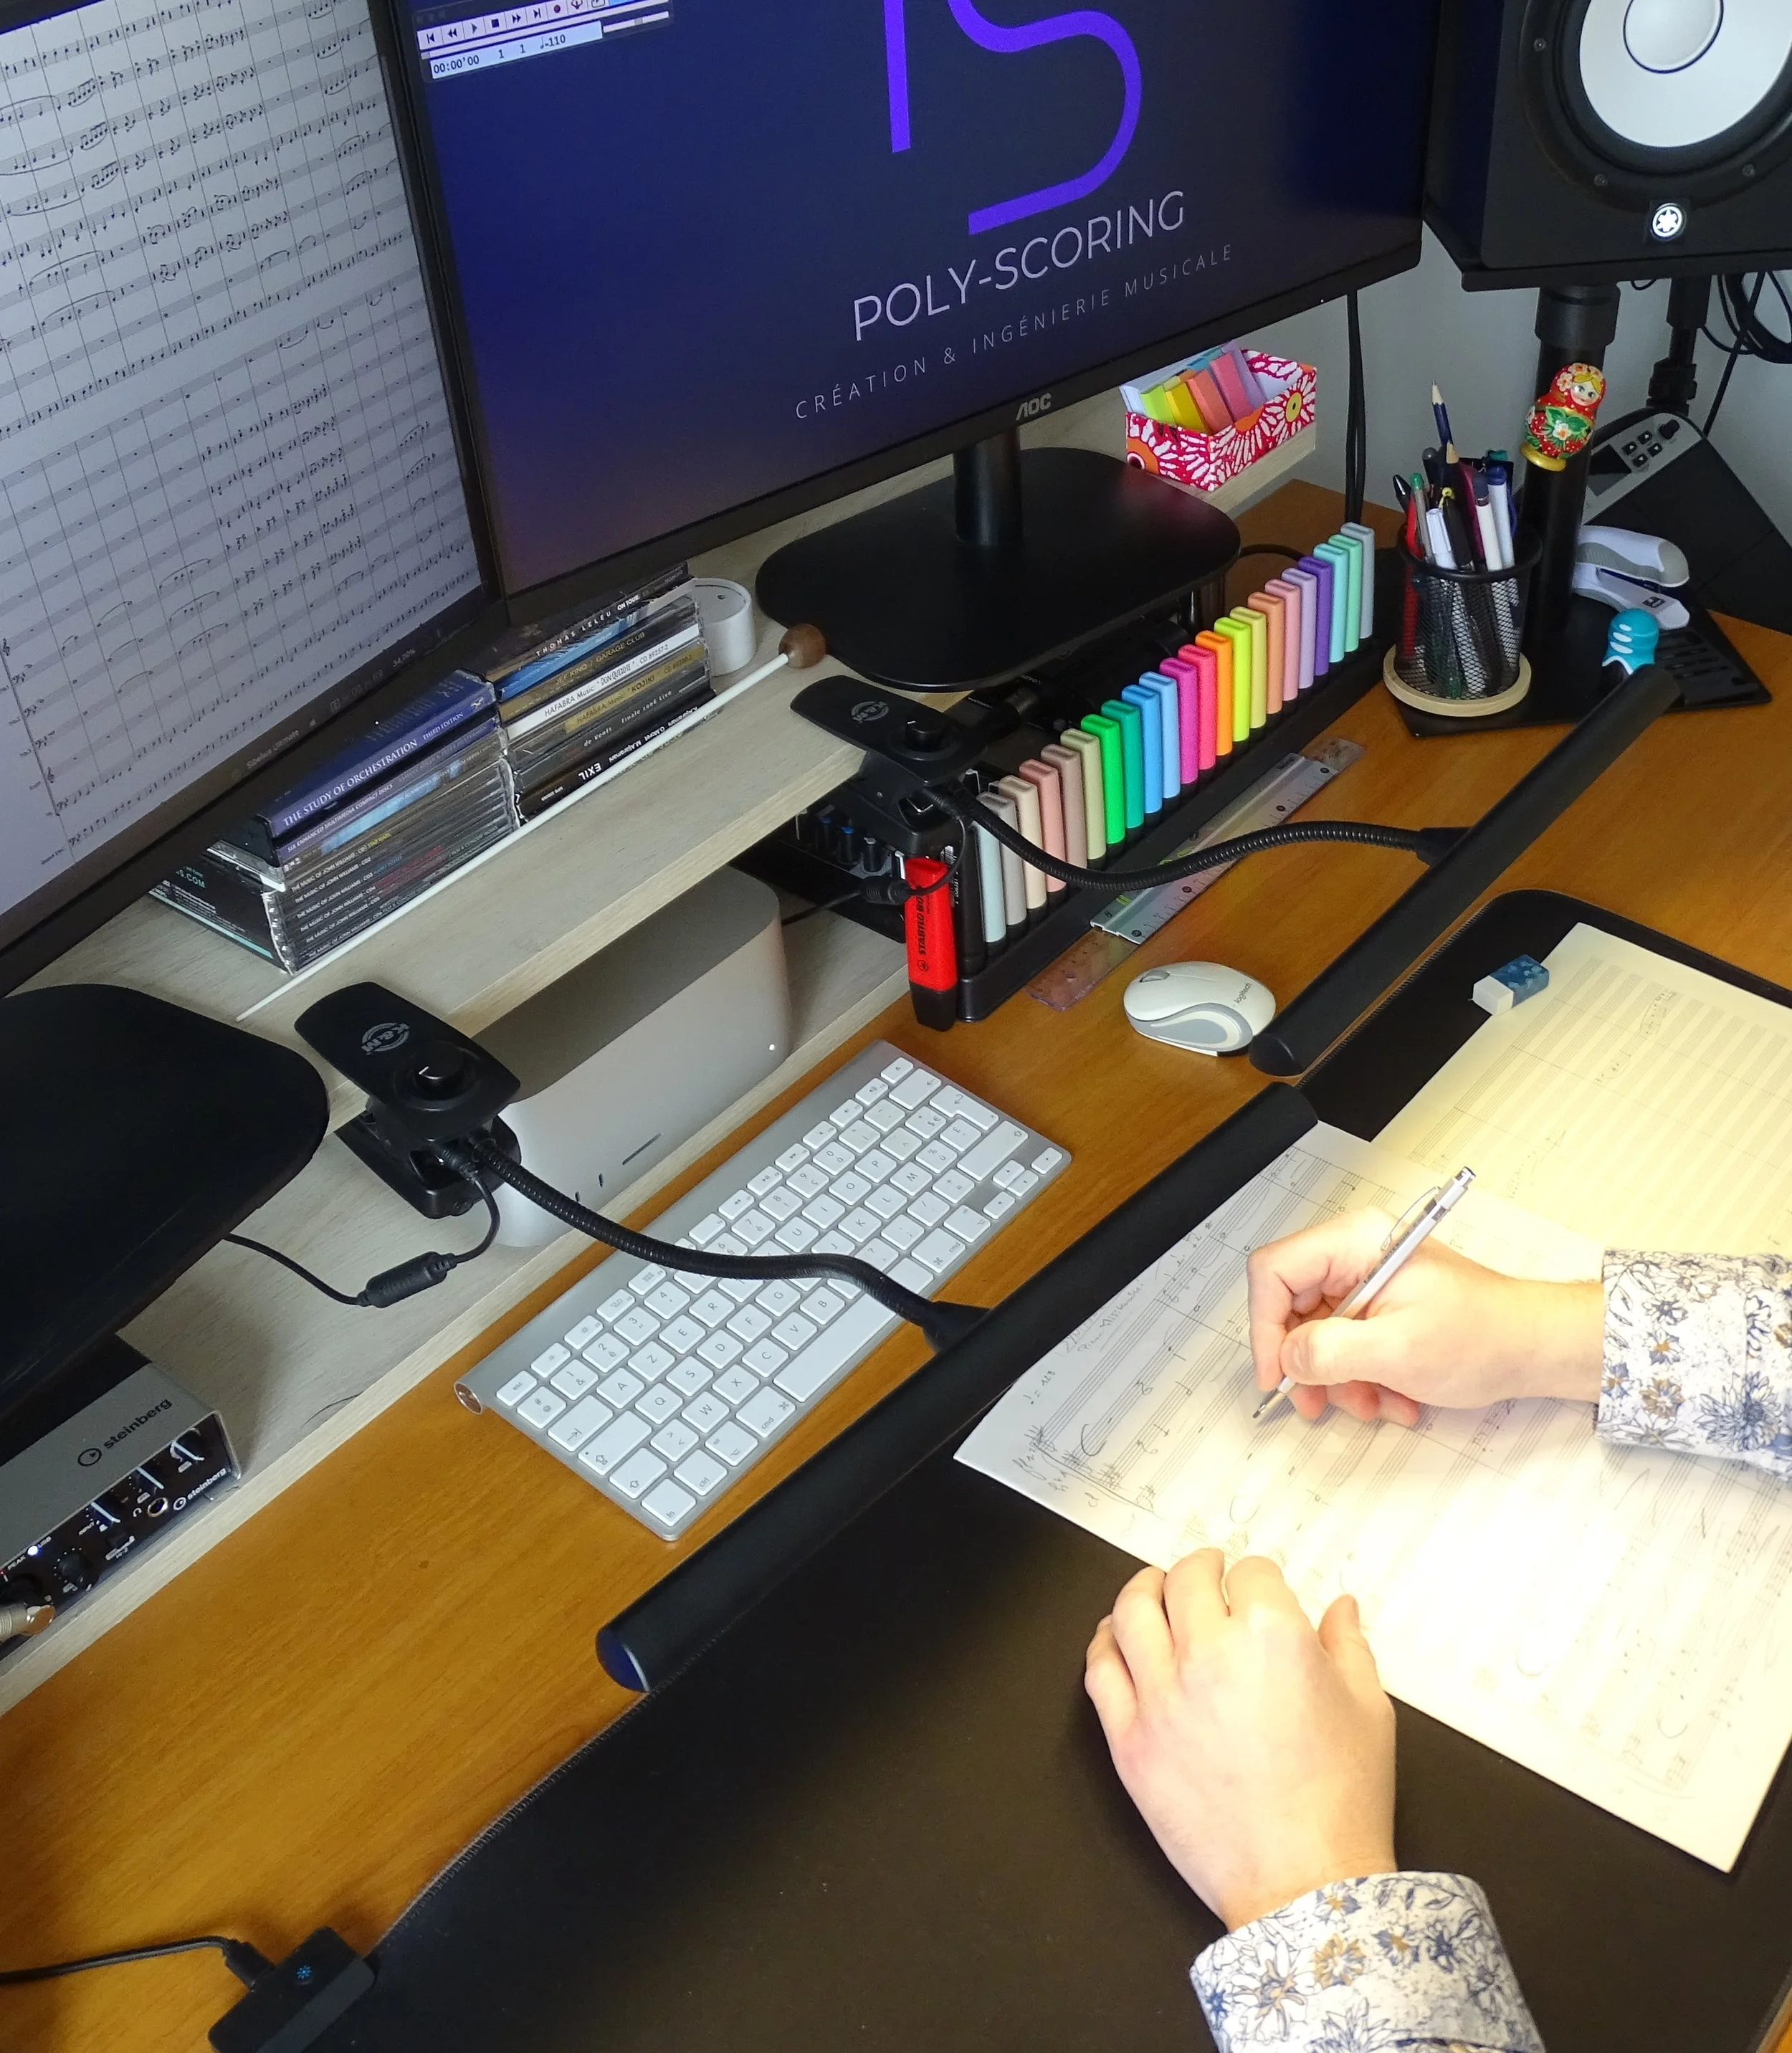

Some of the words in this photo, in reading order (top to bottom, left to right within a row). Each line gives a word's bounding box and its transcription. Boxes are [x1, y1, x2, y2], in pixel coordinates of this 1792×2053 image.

[852, 191, 1185, 342] POLY-SCORING
[796, 358, 927, 419] CRÉATION
[943, 347, 956, 365] &
[972, 288, 1112, 353] INGÉNIERIE
[1123, 244, 1233, 296] MUSICALE
[1016, 392, 1052, 421] AOC
[535, 631, 576, 657] THOMAS
[580, 610, 611, 631] LELEU
[616, 602, 626, 611] ON
[624, 594, 639, 606] TOUR
[594, 642, 626, 662] GARAGE
[625, 632, 645, 645] CLUB
[543, 695, 576, 716] HAFABRA
[638, 655, 647, 664] CD
[593, 726, 612, 740] Vents
[282, 809, 303, 827] THE
[300, 790, 333, 814] STUDY
[331, 781, 348, 796] OF
[345, 738, 419, 788] ORCHESTRATION
[422, 725, 441, 740] THIRD
[439, 711, 464, 729] EDITION
[578, 762, 602, 781] EXIL
[286, 843, 296, 852] SIX
[295, 825, 325, 846] ENHANCED
[323, 806, 355, 829] MULTIMEDIA
[354, 792, 378, 809] COMPACT
[377, 783, 393, 795] DISCS
[300, 875, 315, 887] MUSIC
[321, 864, 335, 875] JOHN
[334, 852, 356, 867] WILLIAMS
[303, 887, 319, 899] MUSIC
[325, 875, 339, 886] JOHN
[338, 863, 359, 878] WILLIAMS
[305, 902, 321, 914] MUSIC
[327, 890, 341, 901] JOHN
[340, 879, 361, 894] WILLIAMS
[308, 916, 324, 928] MUSIC
[330, 904, 344, 915] JOHN
[313, 927, 329, 938] MUSIC
[335, 915, 349, 925] JOHN
[917, 915, 927, 956] STABILO
[1234, 982, 1252, 1004] logitech
[907, 1173, 918, 1181] M
[647, 1355, 657, 1363] Z
[733, 1378, 741, 1387] X
[104, 1399, 172, 1449] steinberg
[700, 1405, 712, 1414] W
[761, 1417, 774, 1430] cmd
[187, 1468, 227, 1500] steinberg
[7, 1556, 26, 1571] PEAK
